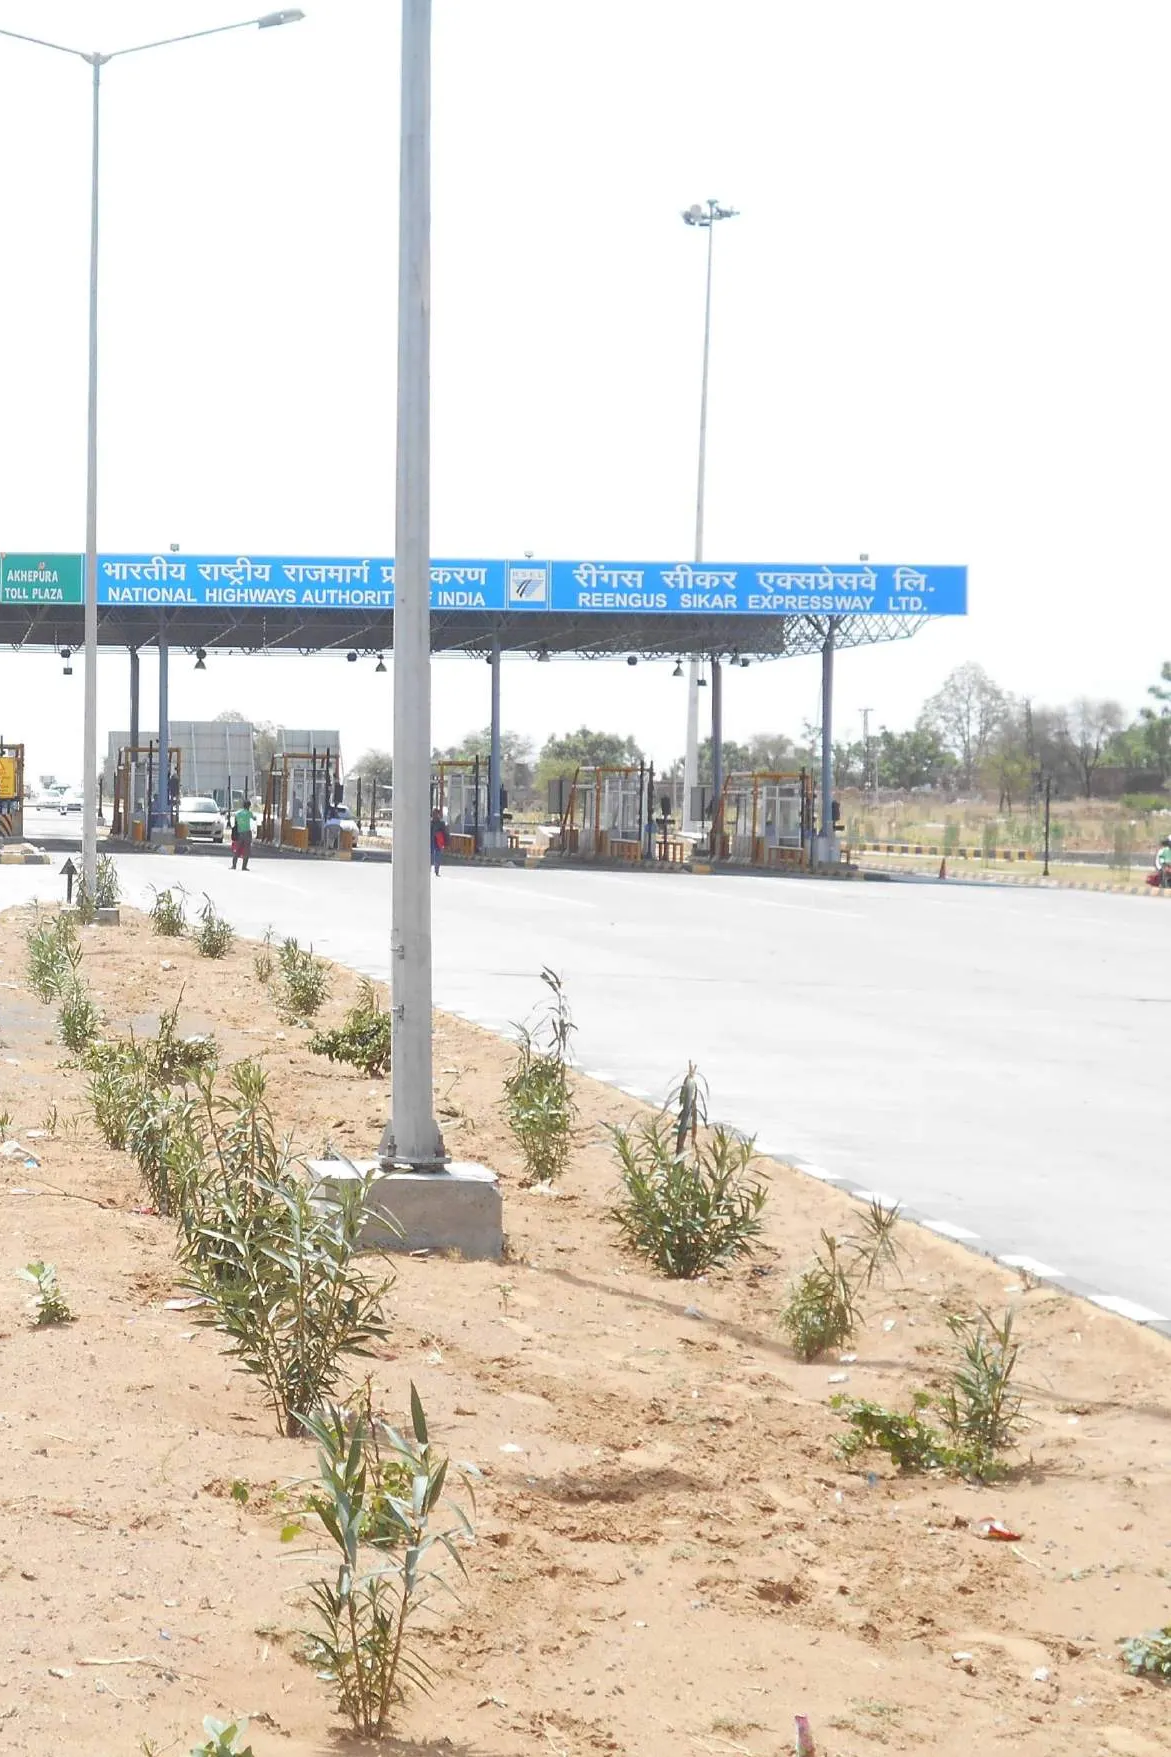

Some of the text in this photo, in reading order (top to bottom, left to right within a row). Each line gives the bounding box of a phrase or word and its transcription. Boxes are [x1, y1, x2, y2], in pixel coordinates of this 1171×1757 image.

[7, 570, 58, 582] AKHEPURA
[102, 556, 186, 580] भारतीय
[197, 557, 272, 585] राष्ट्रीय
[282, 560, 370, 584] राजमार्ग
[572, 563, 935, 592] रींगस सीकर एक्सप्रेसवे लि.
[5, 587, 63, 600] TOLL PLAZA
[108, 587, 197, 602] NATIONAL
[206, 588, 296, 604] HIGHWAYS
[302, 589, 395, 605] AUTHORIT
[438, 592, 485, 606] INDIA
[578, 593, 927, 611] REENGUS SIKAR EXPRESSWAY LTD.
